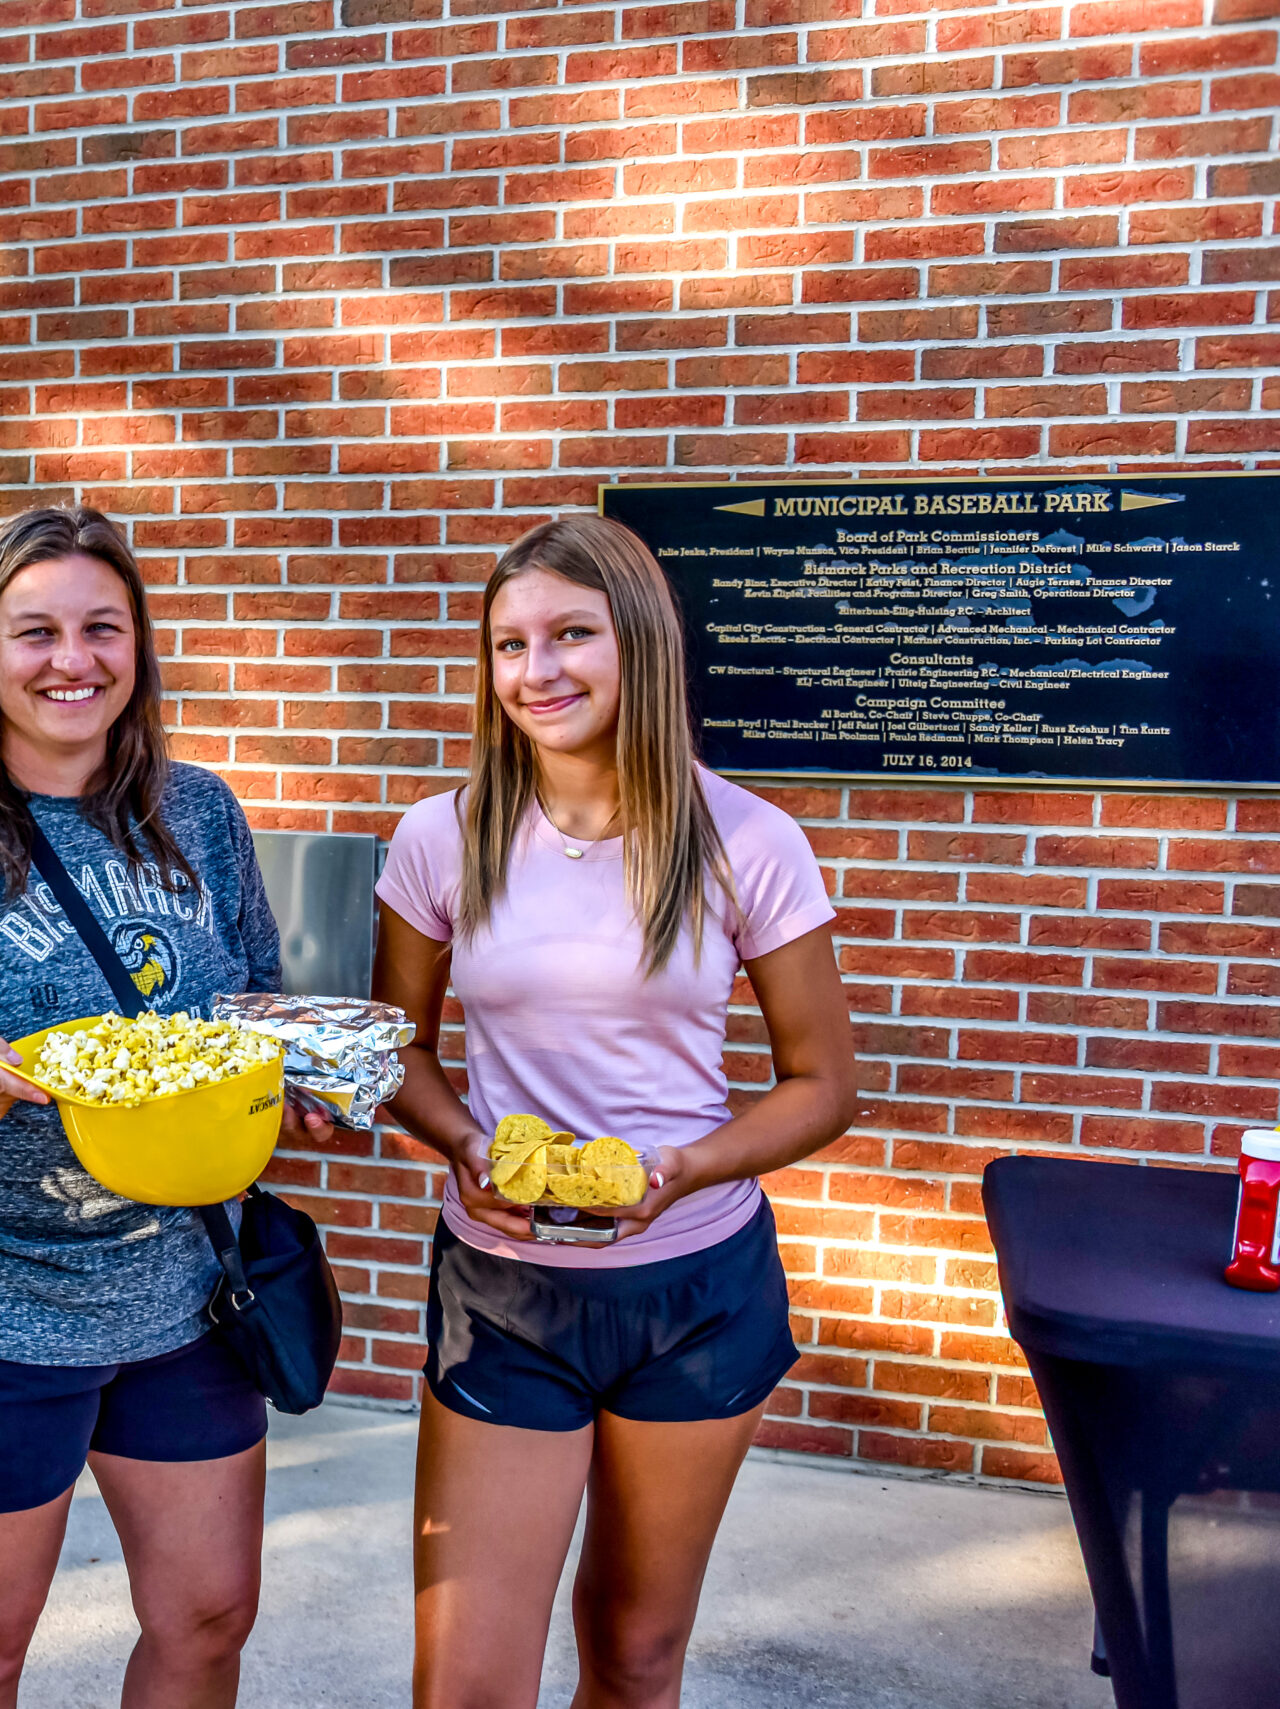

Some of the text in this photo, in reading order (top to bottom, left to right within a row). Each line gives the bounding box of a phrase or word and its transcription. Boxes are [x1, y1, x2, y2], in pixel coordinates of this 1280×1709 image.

[774, 492, 1110, 516] MUNICIPAL BASEBALL PARK
[836, 530, 1040, 543] Board of Park Commissioners
[708, 547, 754, 556] President
[838, 546, 860, 555] Vice
[860, 546, 908, 555] President
[990, 544, 1030, 554] Jennifer
[1032, 544, 1076, 553] DeForest
[1086, 543, 1112, 553] Mike
[1113, 543, 1162, 553] Schwartz
[1172, 542, 1202, 552] Jason
[1204, 542, 1240, 552] Starck
[804, 562, 1072, 575] Bismarck Parks and Recreation District
[770, 578, 816, 587] Executive
[818, 577, 858, 587] Director
[924, 577, 964, 586] Finance
[964, 577, 1006, 586] Director
[1016, 577, 1046, 588] Augie
[1086, 576, 1128, 586] Finance
[1128, 576, 1172, 586] Director
[852, 589, 872, 598] and
[872, 589, 920, 600] Programs
[922, 589, 962, 598] Director
[972, 589, 998, 600] Greg
[1000, 589, 1030, 599] Smith,
[1034, 588, 1092, 600] Operations
[1092, 588, 1136, 598] Director
[984, 606, 1032, 616] Architect
[764, 623, 826, 633] Construction
[834, 624, 874, 633] General
[874, 624, 928, 633] Contractor
[936, 624, 988, 633] Advanced
[988, 624, 1048, 634] Mechanical
[1056, 624, 1116, 634] Mechanical
[1118, 624, 1176, 634] Contractor
[842, 635, 895, 644] Contractor
[1044, 635, 1084, 647] Parking
[1086, 635, 1102, 645] Lot
[1104, 636, 1162, 645] Contractor
[888, 652, 974, 665] Consultants
[727, 665, 774, 675] Structural
[782, 666, 830, 675] Structural
[832, 666, 876, 678] Engineer
[884, 666, 918, 676] Prairie
[920, 667, 980, 679] Engineering
[1008, 668, 1120, 678] Mechanical/Electrical
[1122, 669, 1170, 681] Engineer
[820, 678, 844, 687] Civil
[846, 678, 890, 689] Engineer
[928, 679, 990, 690] Engineering
[1000, 680, 1024, 689] Civil
[1024, 680, 1070, 691] Engineer
[856, 696, 1006, 711] Campaign Committee
[908, 721, 960, 731] Gilbertson
[1002, 723, 1032, 732] Keller
[1042, 723, 1066, 733] Russ
[1068, 724, 1110, 734] Kroshus
[1119, 724, 1138, 734] Tim
[1140, 725, 1172, 735] Kuntz
[1002, 734, 1054, 745] Thompson
[1062, 734, 1094, 744] Helen
[1094, 735, 1126, 747] Tracy
[882, 754, 972, 769] JULY 16, 2014
